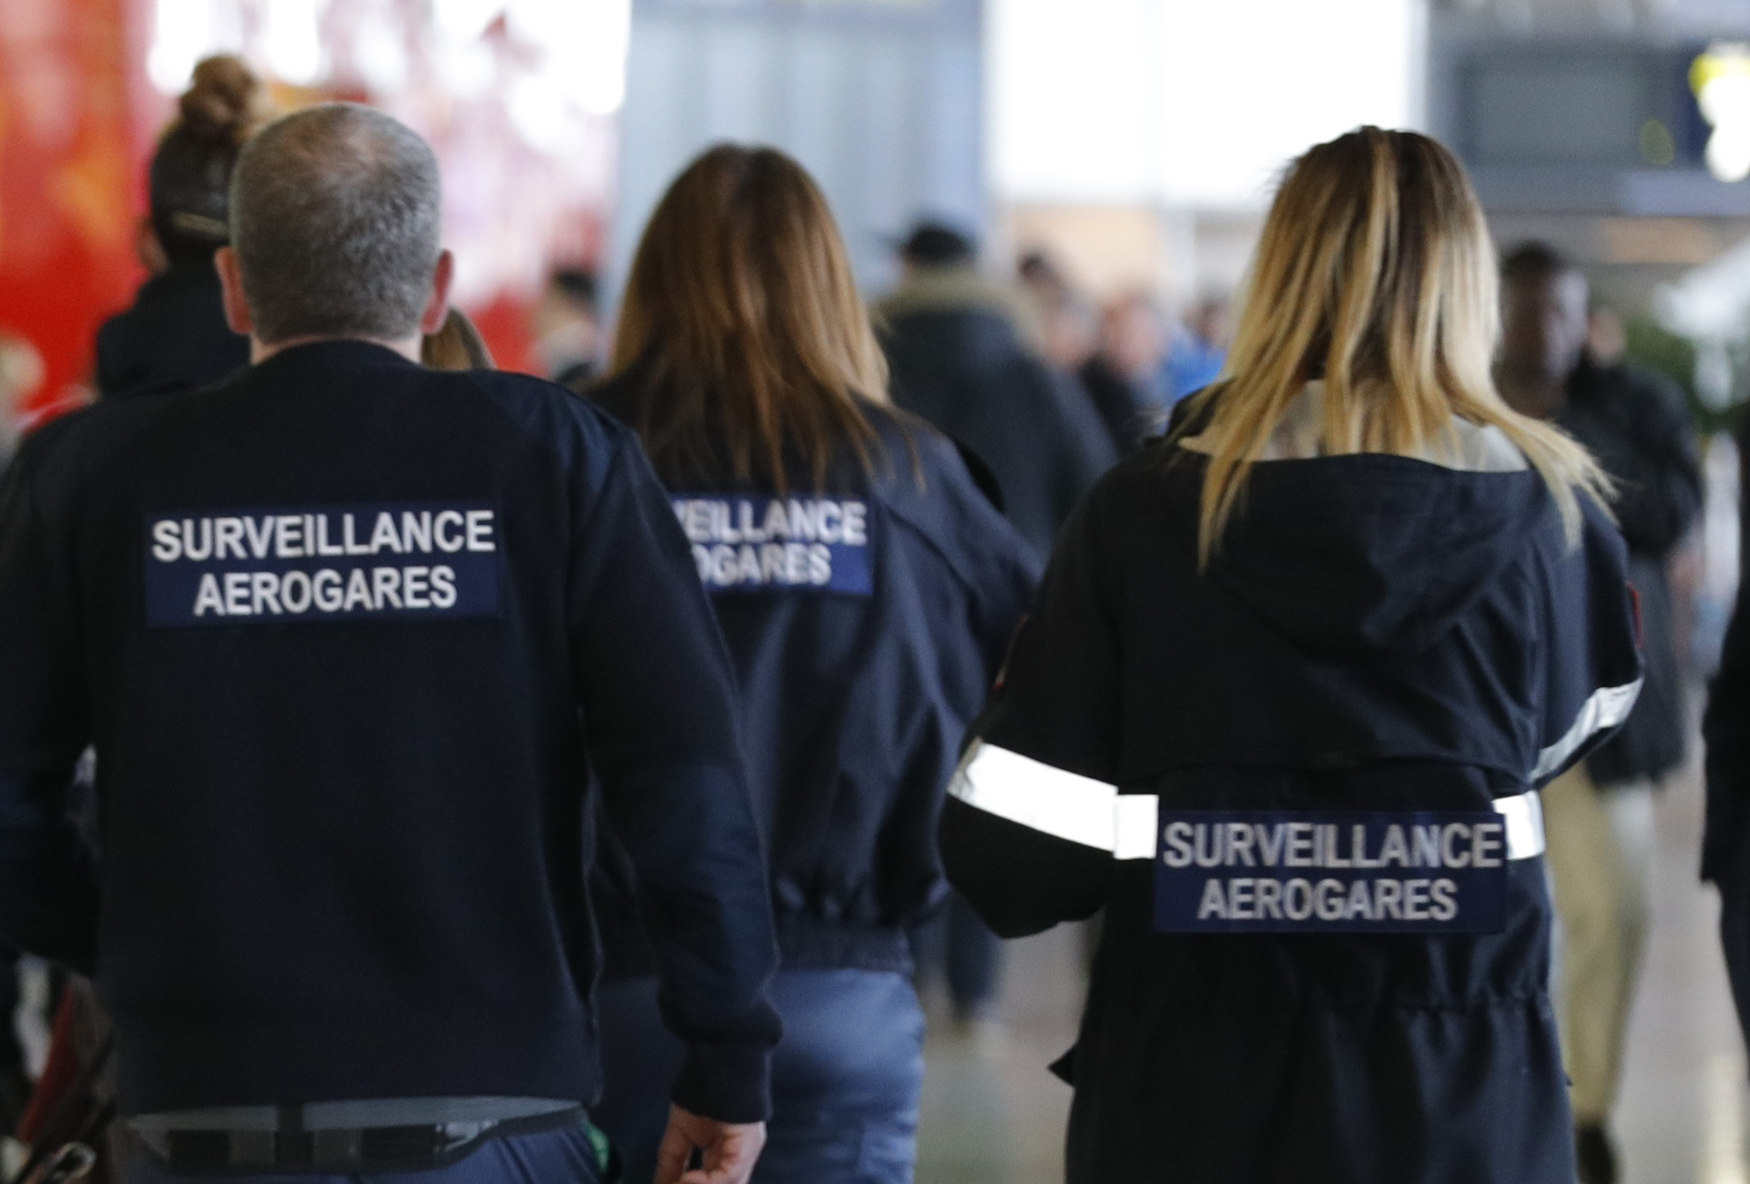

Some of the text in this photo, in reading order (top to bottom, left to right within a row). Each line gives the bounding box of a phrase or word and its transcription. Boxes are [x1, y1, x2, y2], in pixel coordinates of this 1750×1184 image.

[152, 510, 496, 562] SURVEILLANCE
[193, 565, 457, 617] AEROGARES
[1163, 821, 1503, 868] SURVEILLANCE
[1198, 877, 1459, 921] AEROGARES
